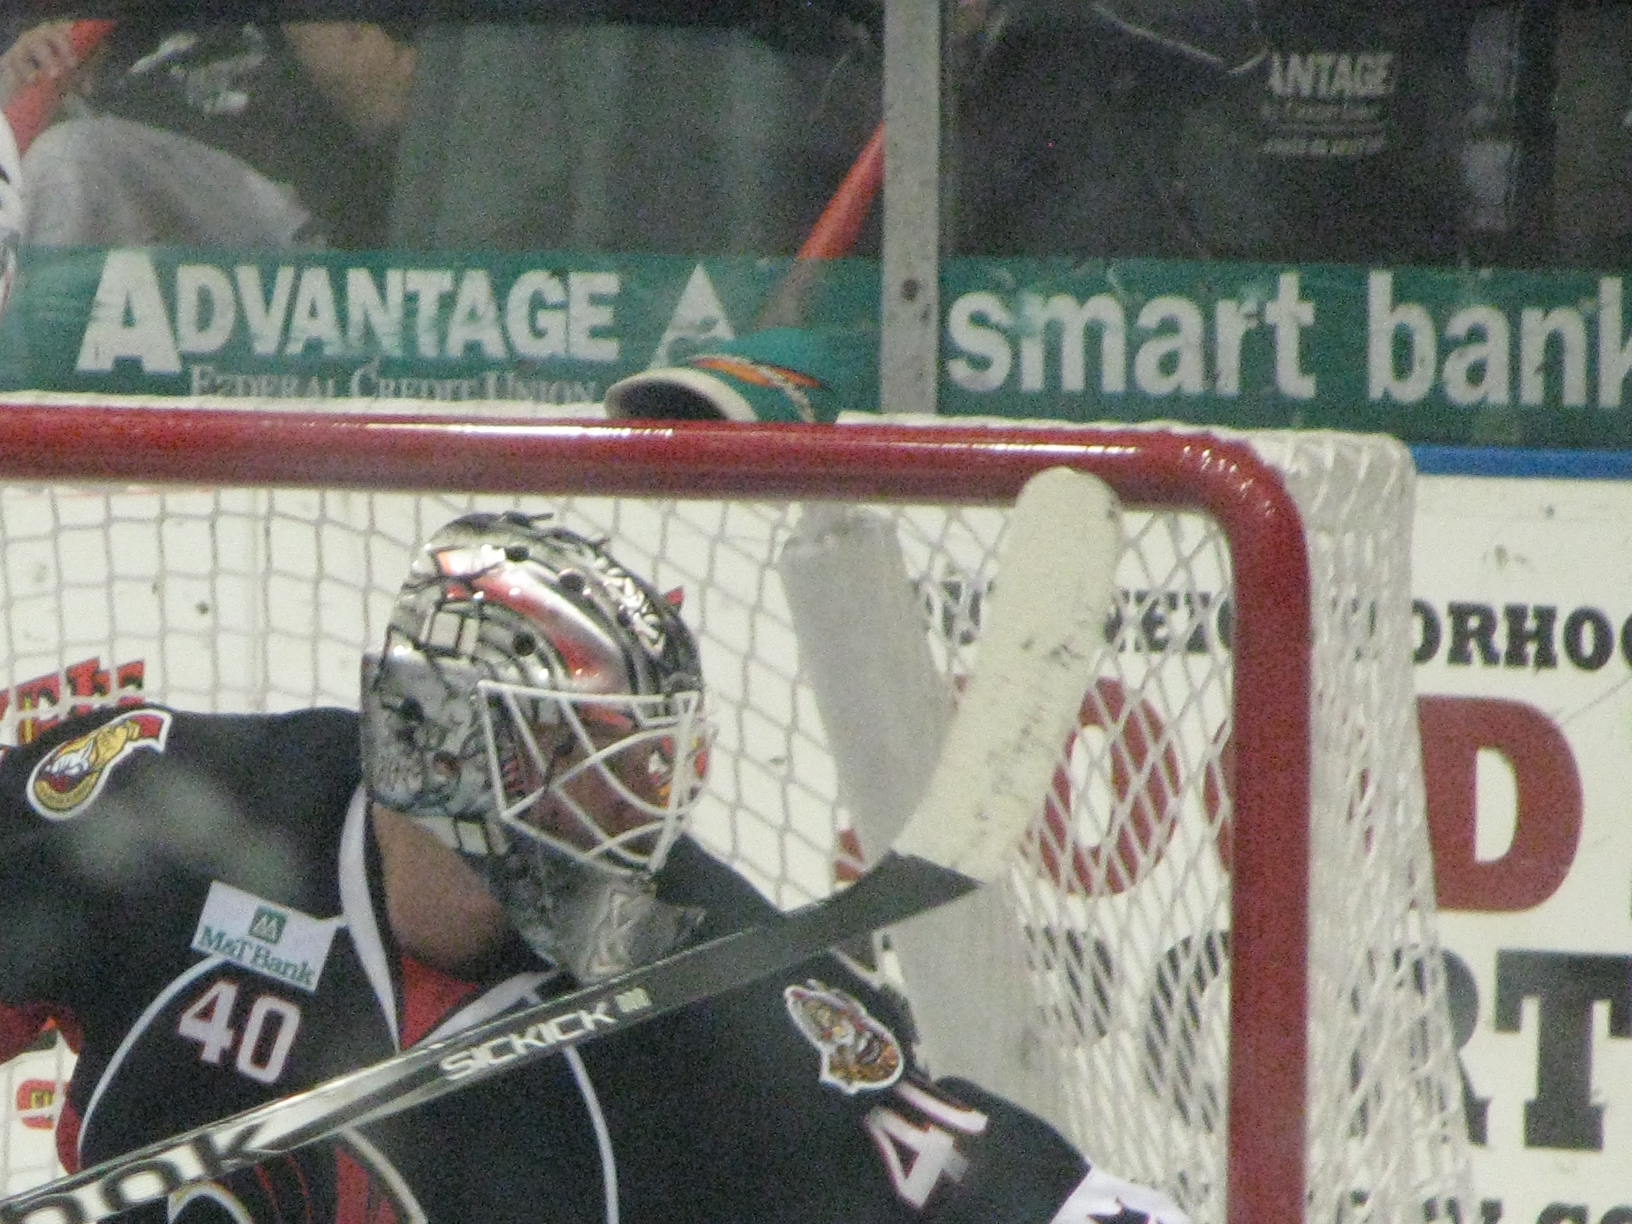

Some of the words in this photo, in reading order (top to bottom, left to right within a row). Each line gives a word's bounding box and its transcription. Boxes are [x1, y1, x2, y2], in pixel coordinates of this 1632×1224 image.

[74, 248, 622, 375] ADVANTAGE
[946, 271, 1317, 400] smart
[177, 978, 302, 1085] 40
